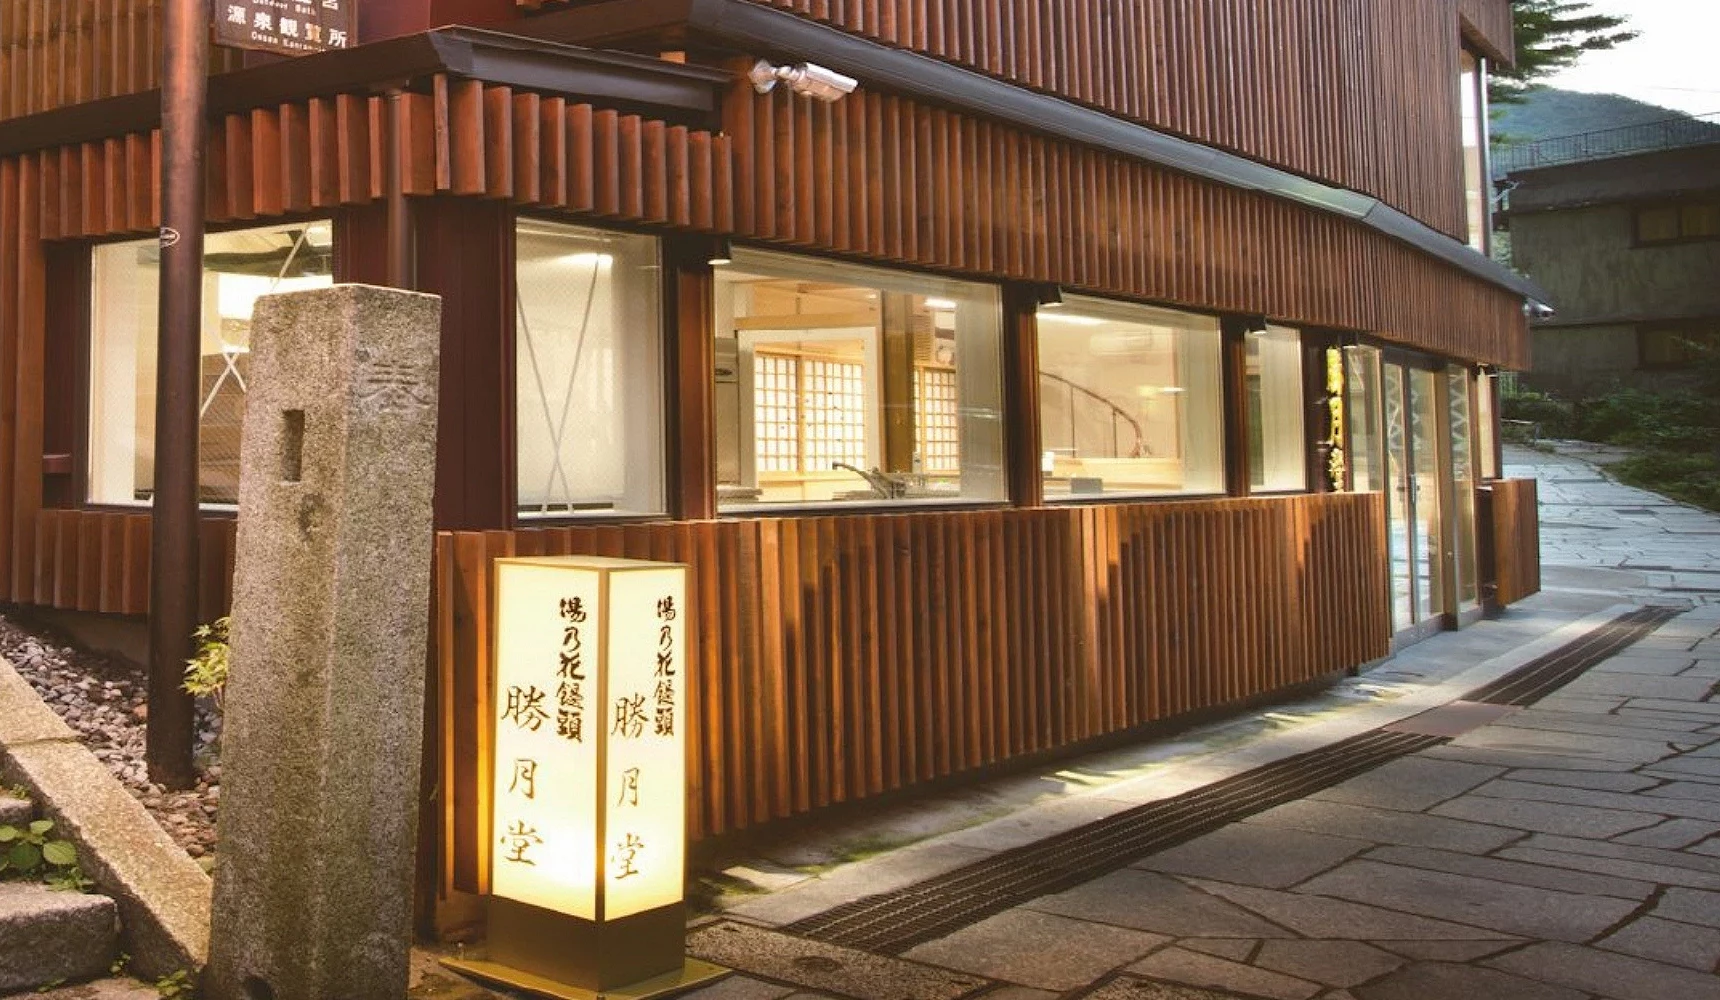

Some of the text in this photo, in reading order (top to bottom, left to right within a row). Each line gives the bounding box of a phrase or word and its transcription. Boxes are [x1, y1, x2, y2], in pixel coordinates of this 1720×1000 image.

[500, 685, 551, 866] 勝月堂
[611, 692, 650, 880] 勝月堂
